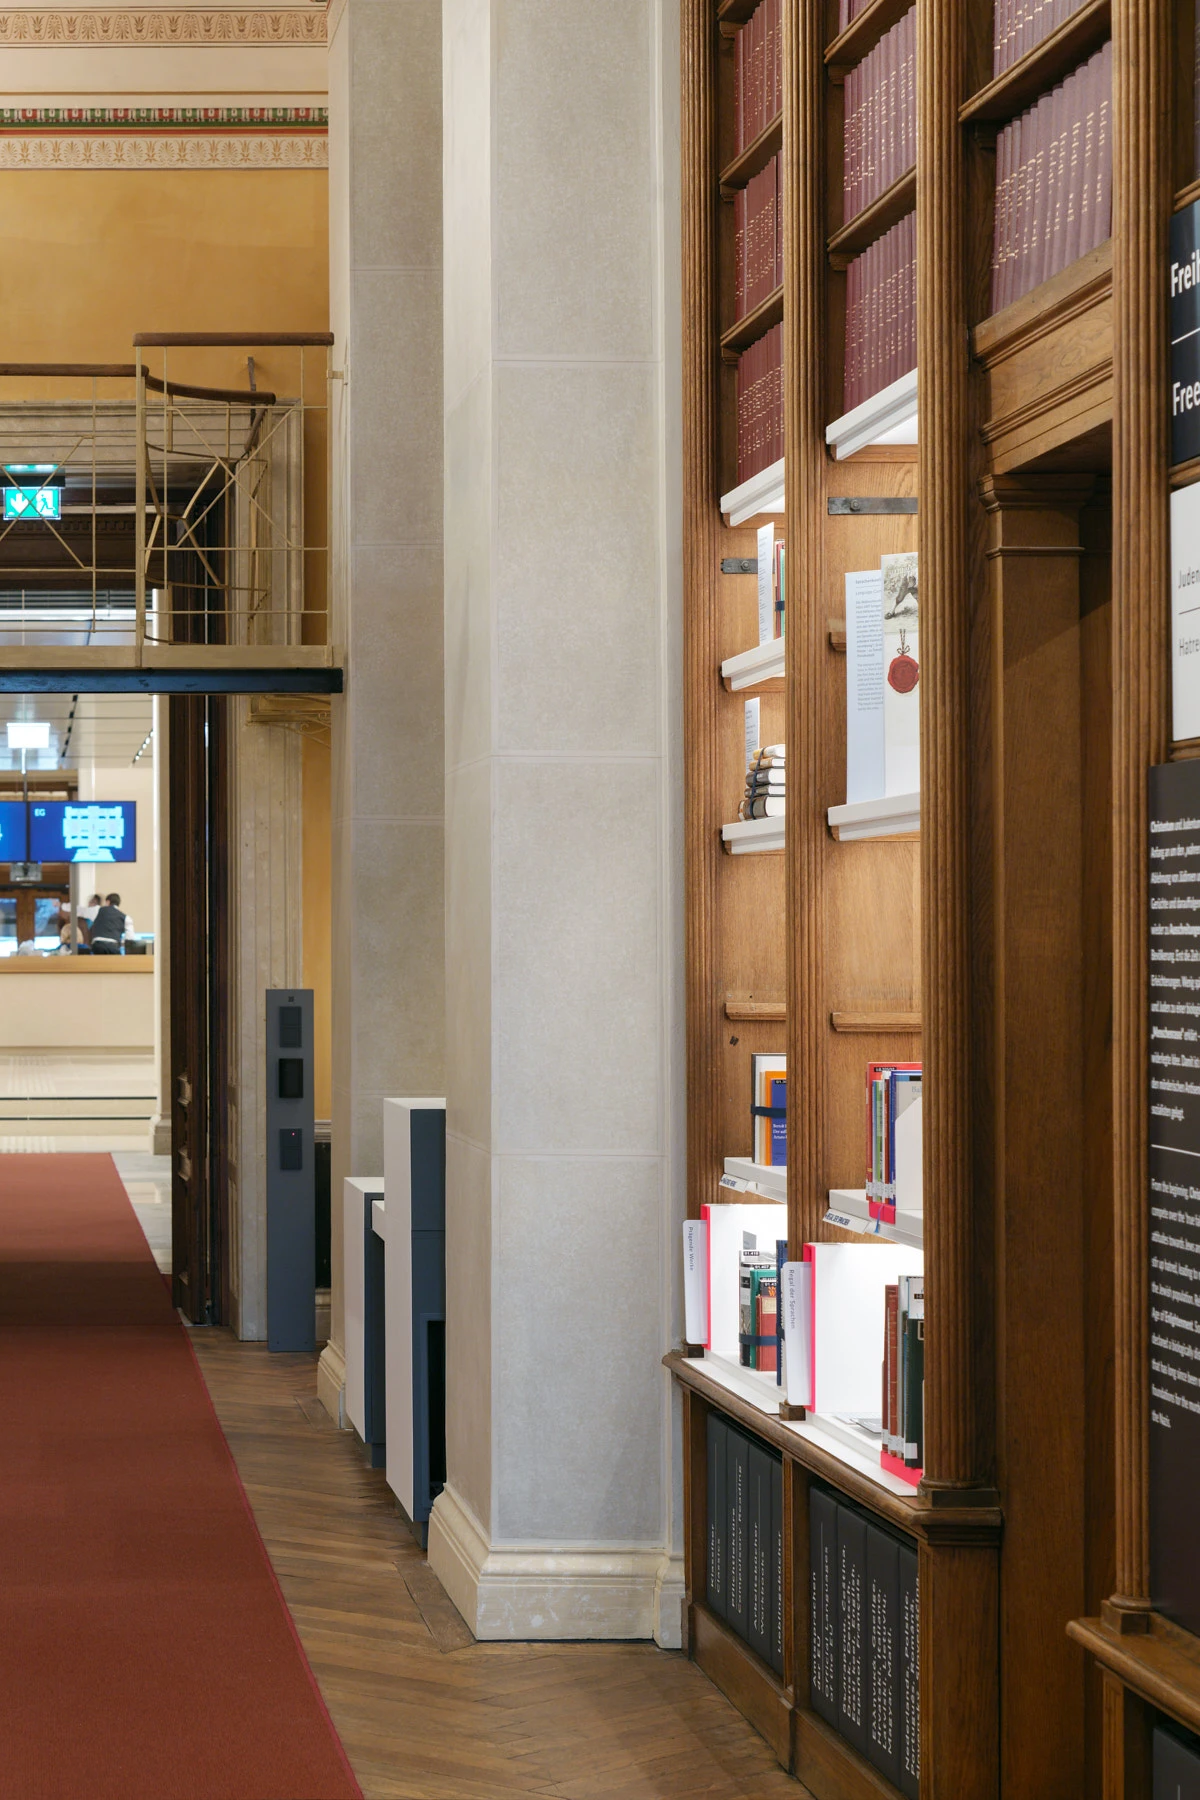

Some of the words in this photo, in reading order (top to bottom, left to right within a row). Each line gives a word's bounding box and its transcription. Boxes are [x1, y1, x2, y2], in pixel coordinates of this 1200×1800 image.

[34, 808, 46, 817] EG
[816, 1635, 821, 1659] EU
[829, 1623, 834, 1648] EU
